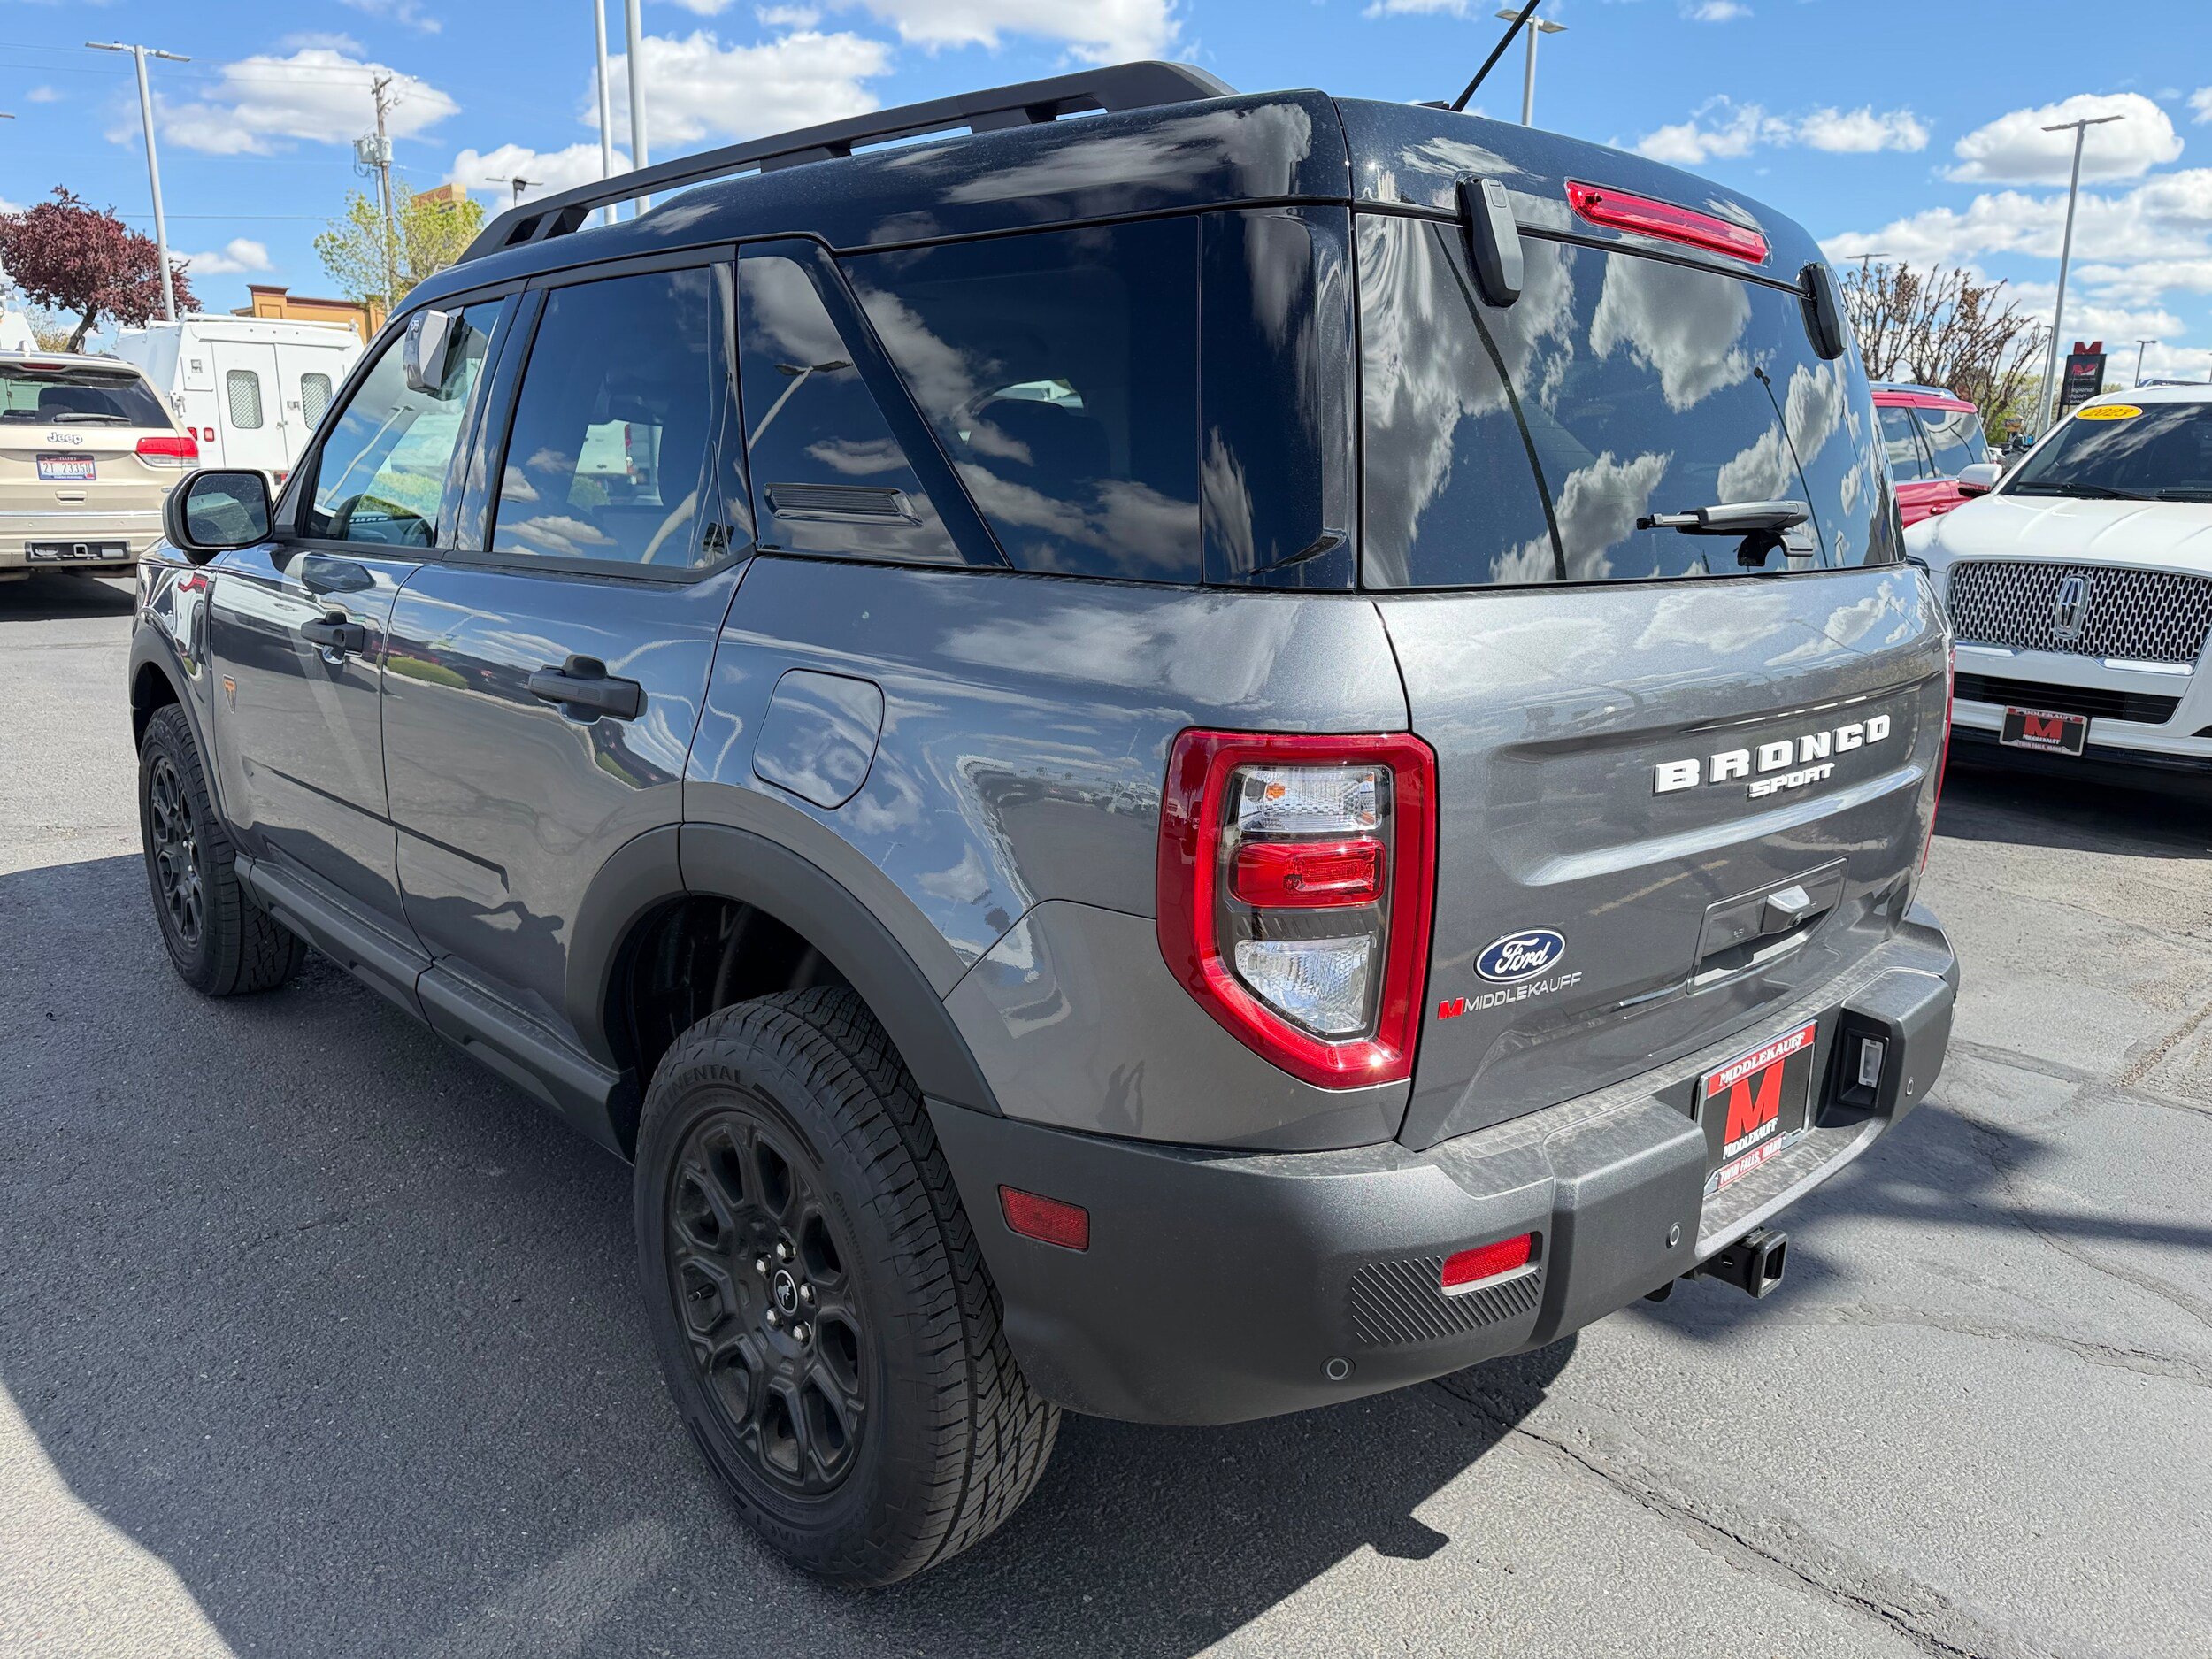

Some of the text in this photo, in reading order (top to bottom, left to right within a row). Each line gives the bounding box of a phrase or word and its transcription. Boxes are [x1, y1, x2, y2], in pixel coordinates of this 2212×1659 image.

[47, 432, 83, 445] Jeep
[43, 462, 55, 473] 2T
[2024, 715, 2063, 739] M
[1654, 714, 1891, 793] BRONCO
[1747, 762, 1835, 798] SPORT
[1494, 937, 1552, 974] Ford
[1463, 972, 1582, 1013] MIDDLEKAUFF
[1718, 1031, 1805, 1087] MIDDLEKAUFF
[1724, 1058, 1786, 1145] M
[1723, 1117, 1778, 1160] MIDDLEKAUFF
[1720, 1166, 1740, 1185] TWIN
[1763, 1138, 1783, 1157] IDAHO
